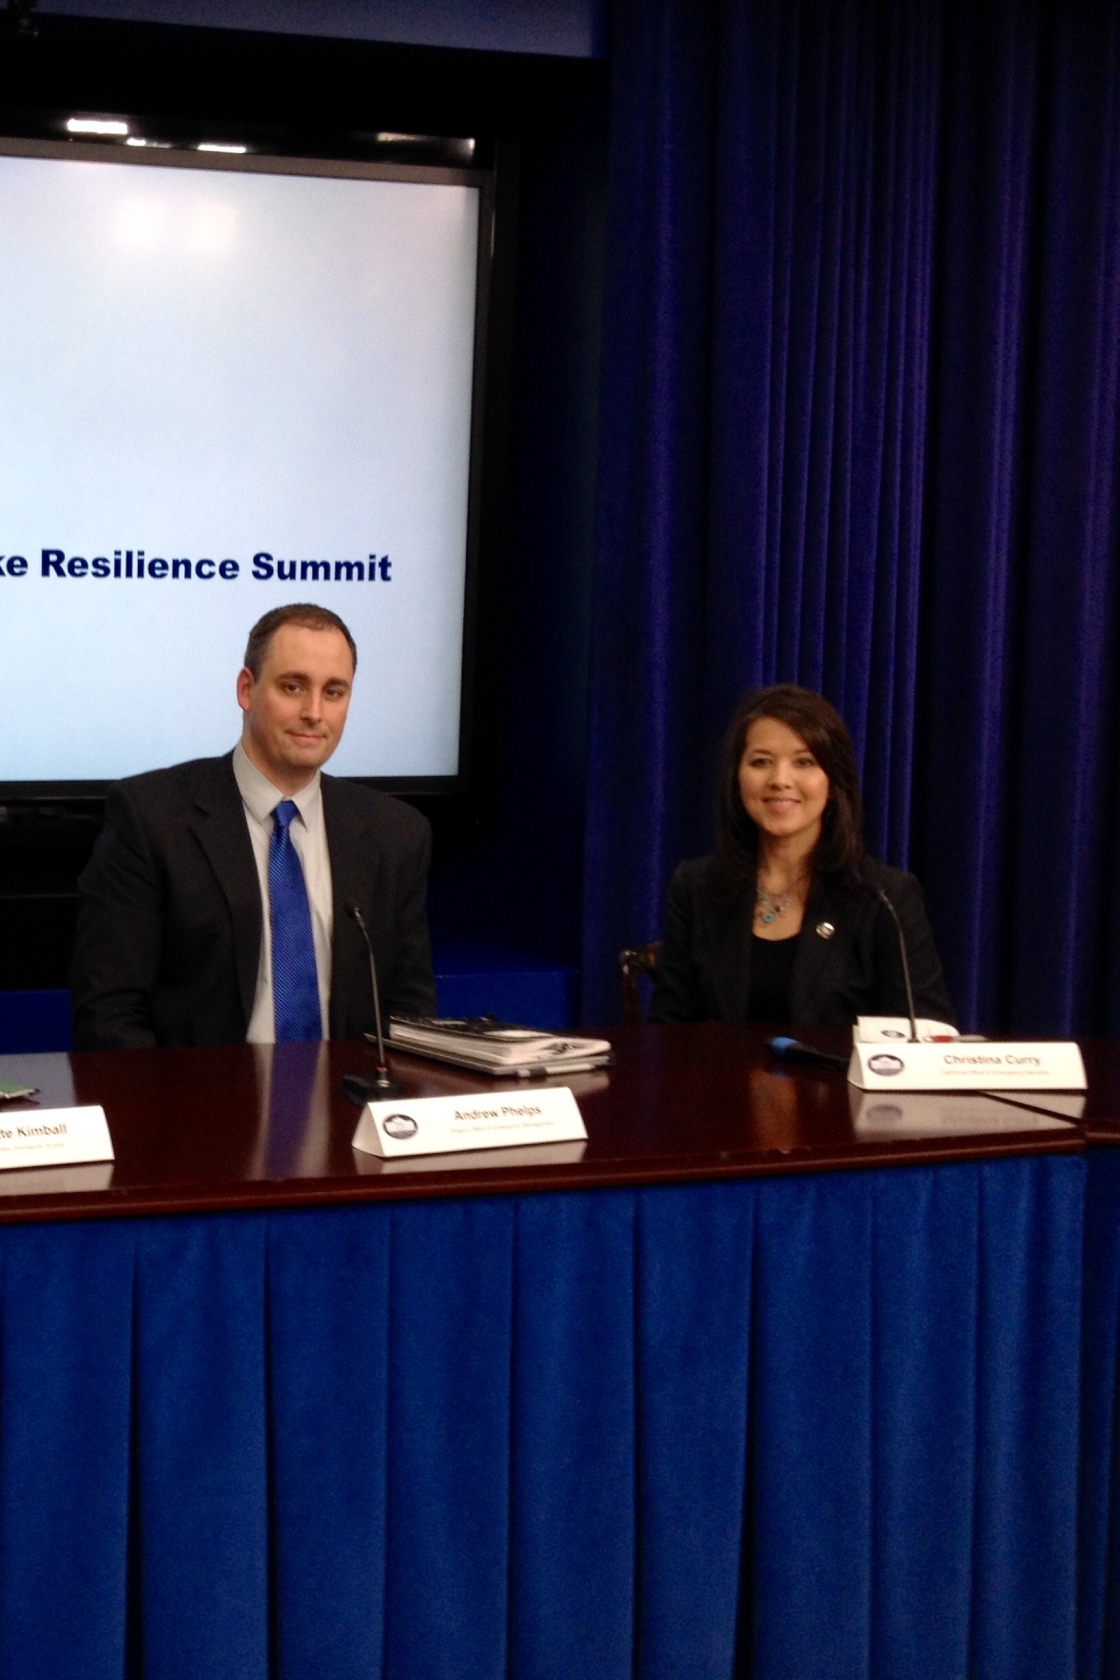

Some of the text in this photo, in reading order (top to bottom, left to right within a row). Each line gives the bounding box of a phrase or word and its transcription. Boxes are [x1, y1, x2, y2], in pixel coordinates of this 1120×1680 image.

[41, 548, 240, 581] Resilience
[252, 552, 392, 581] Summit
[944, 1054, 1041, 1067] Christina Curry
[454, 1105, 542, 1120] Andrew Phelps
[16, 1123, 68, 1138] Kimball
